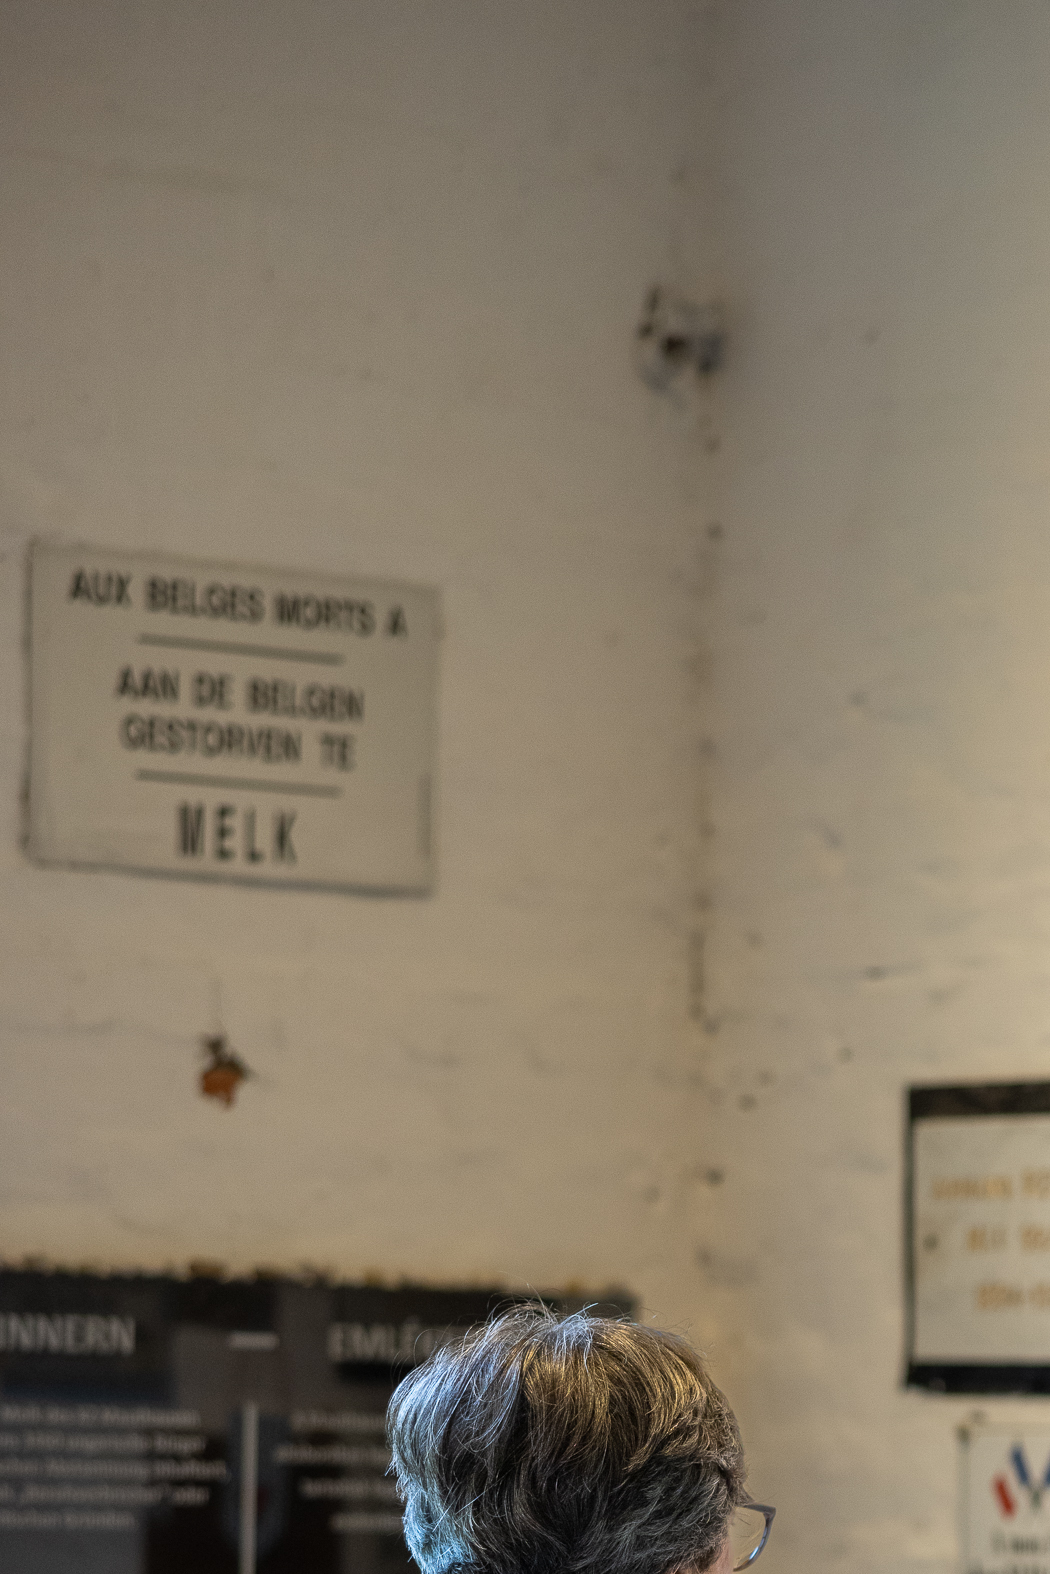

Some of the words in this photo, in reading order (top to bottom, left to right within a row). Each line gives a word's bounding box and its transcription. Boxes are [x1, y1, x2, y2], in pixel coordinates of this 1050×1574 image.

[70, 569, 132, 605] AUX
[145, 576, 266, 623] BELGES
[274, 589, 376, 637] MORTS
[116, 664, 180, 700] AAN
[194, 672, 234, 709] DE
[246, 677, 364, 721] BELGEN
[122, 714, 302, 764] GESTORVEN
[320, 732, 356, 772] TE
[178, 803, 298, 864] MELK
